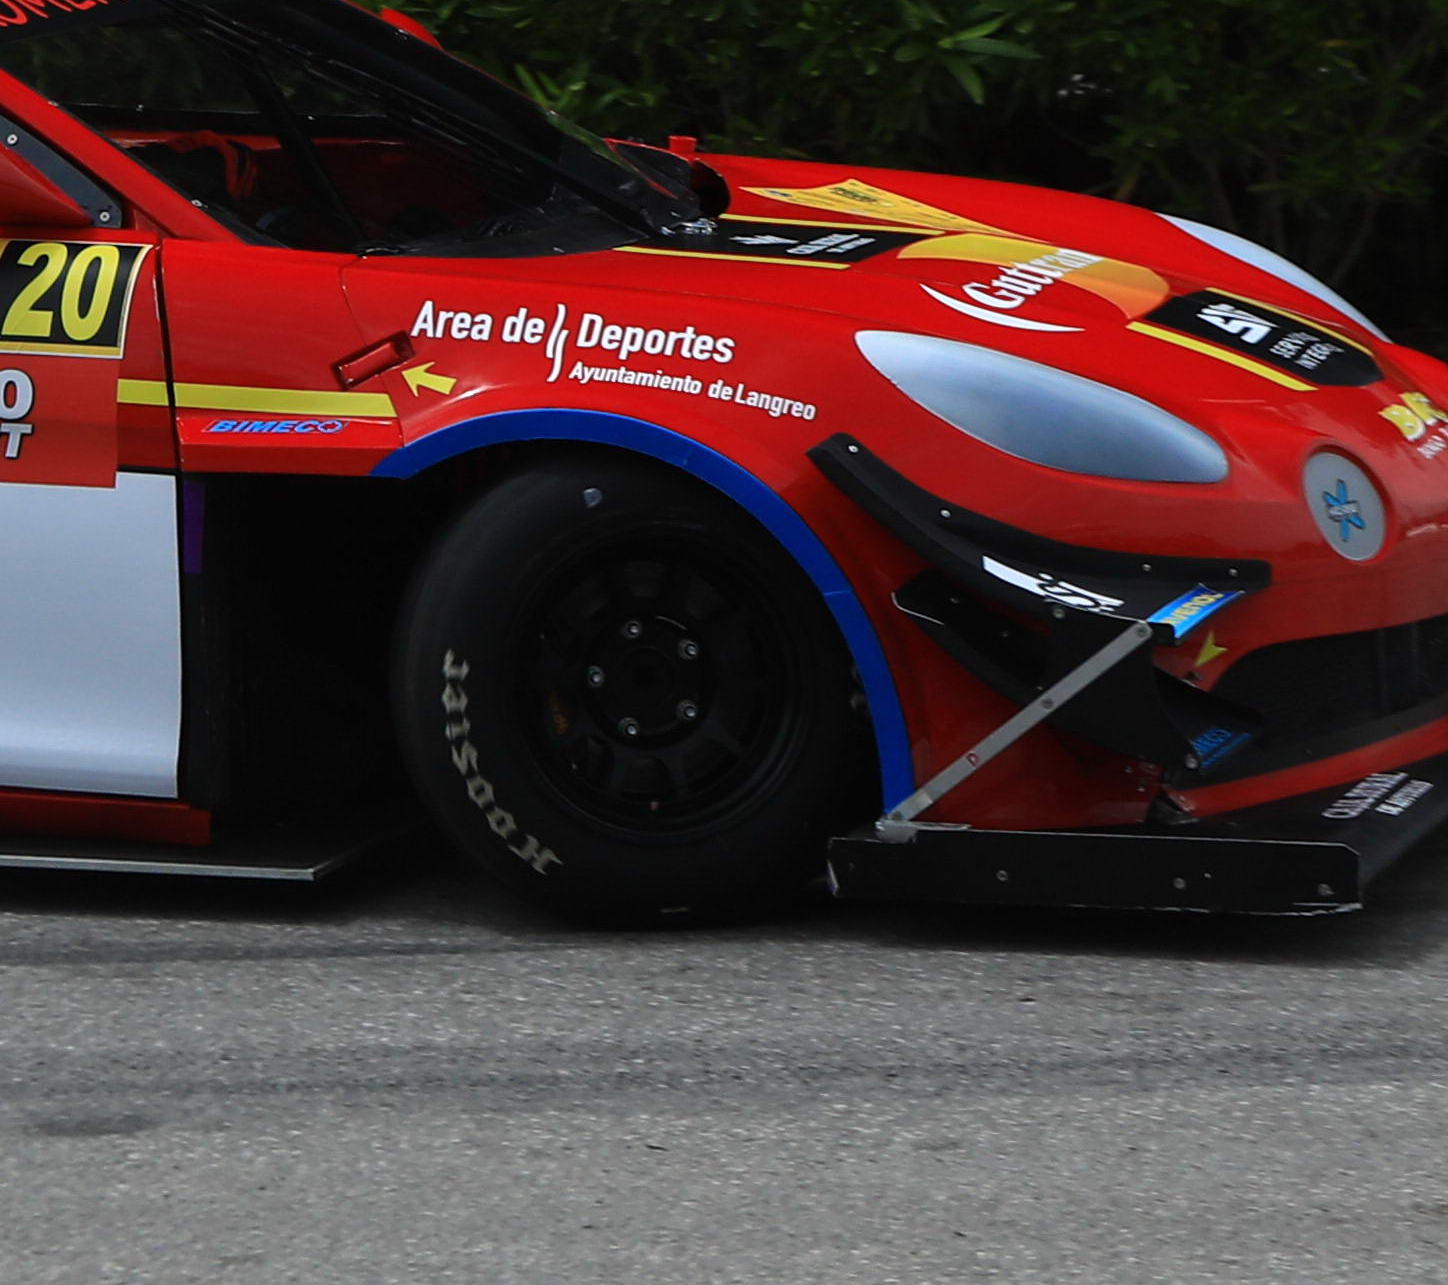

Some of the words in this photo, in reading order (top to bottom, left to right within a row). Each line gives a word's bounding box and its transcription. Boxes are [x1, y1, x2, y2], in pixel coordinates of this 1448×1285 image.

[0, 242, 121, 341] 20
[411, 299, 492, 343] Area
[502, 307, 545, 344] de
[575, 313, 736, 364] Deportes
[568, 360, 702, 396] Ayuntamiento
[707, 378, 733, 401] de
[734, 381, 817, 421] Langreo
[206, 419, 345, 434] BIMECO
